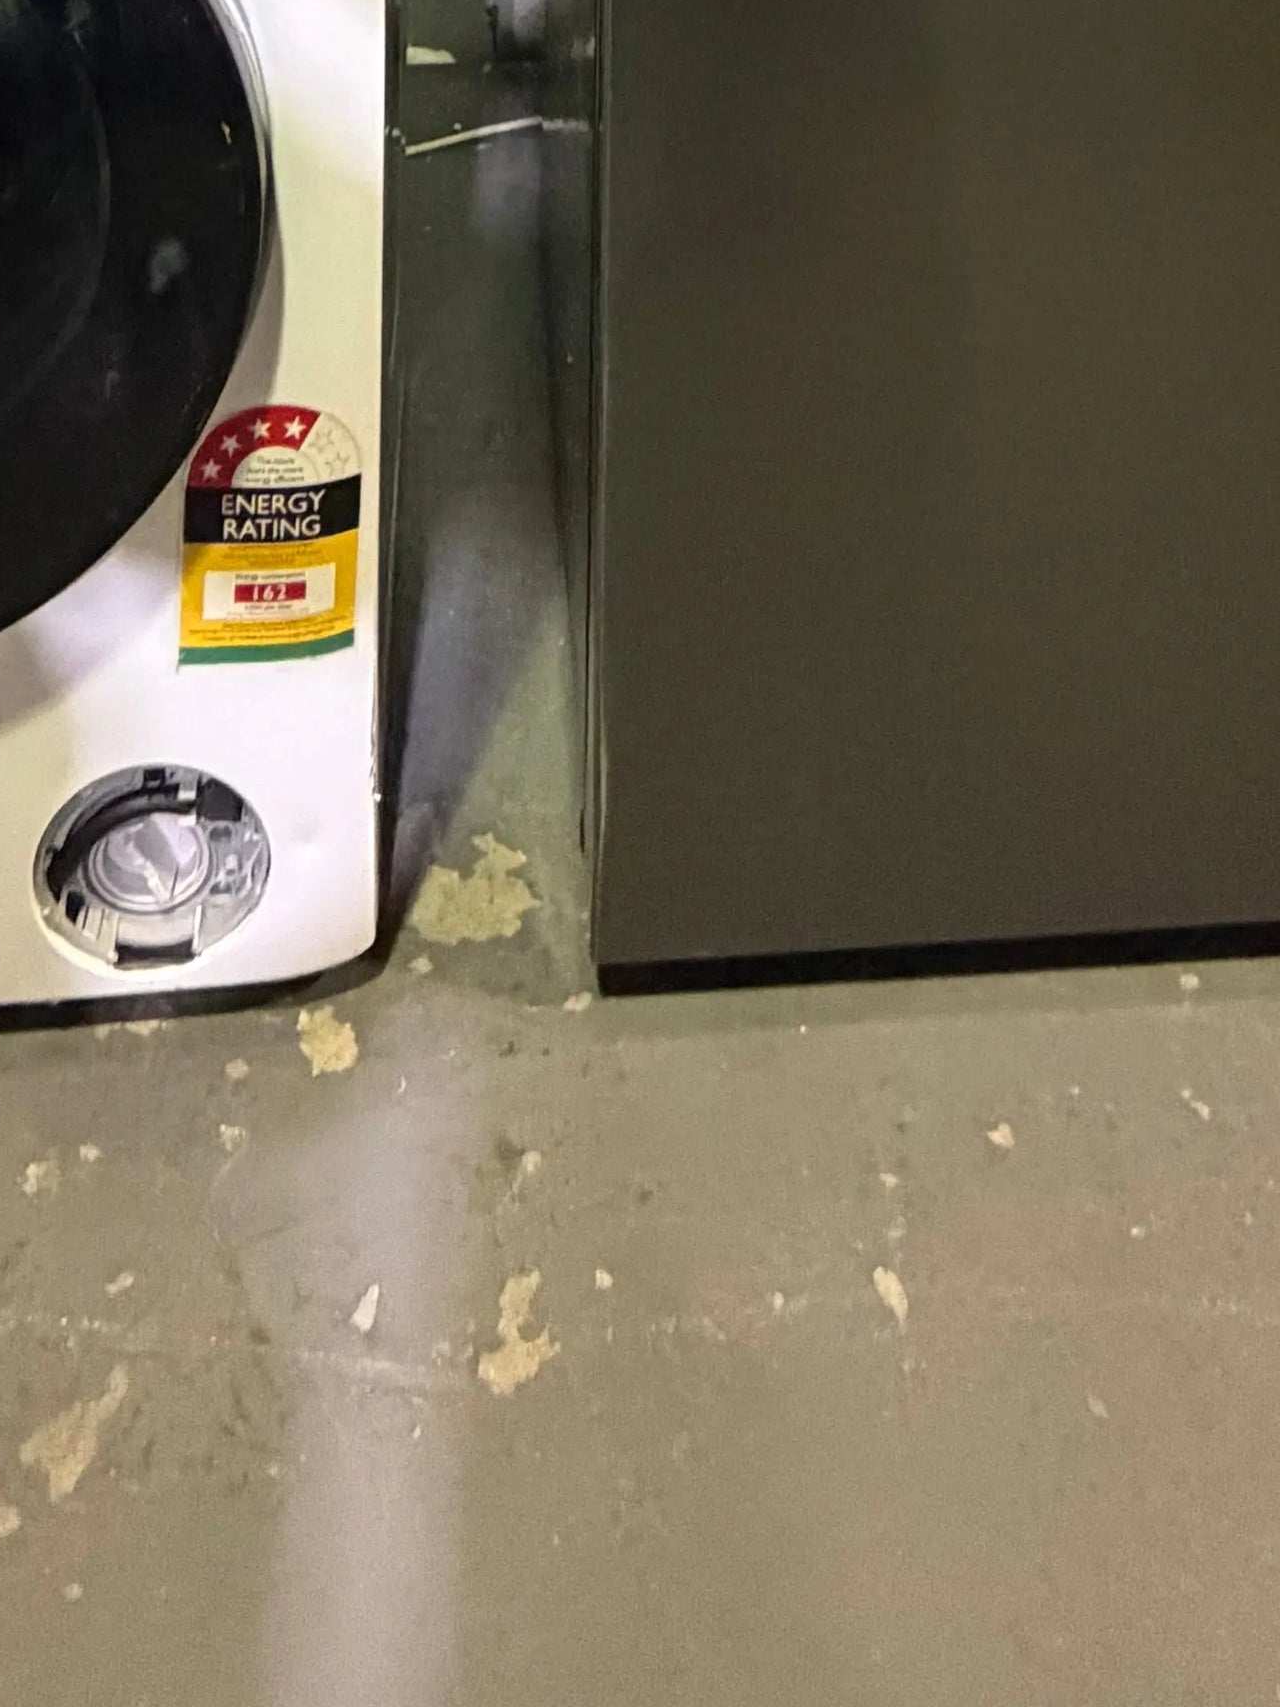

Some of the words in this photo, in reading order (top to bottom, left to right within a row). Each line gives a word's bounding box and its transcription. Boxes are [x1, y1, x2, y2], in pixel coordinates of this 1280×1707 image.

[221, 489, 326, 517] ENERGY
[223, 514, 321, 541] RATING
[252, 584, 287, 601] 162
